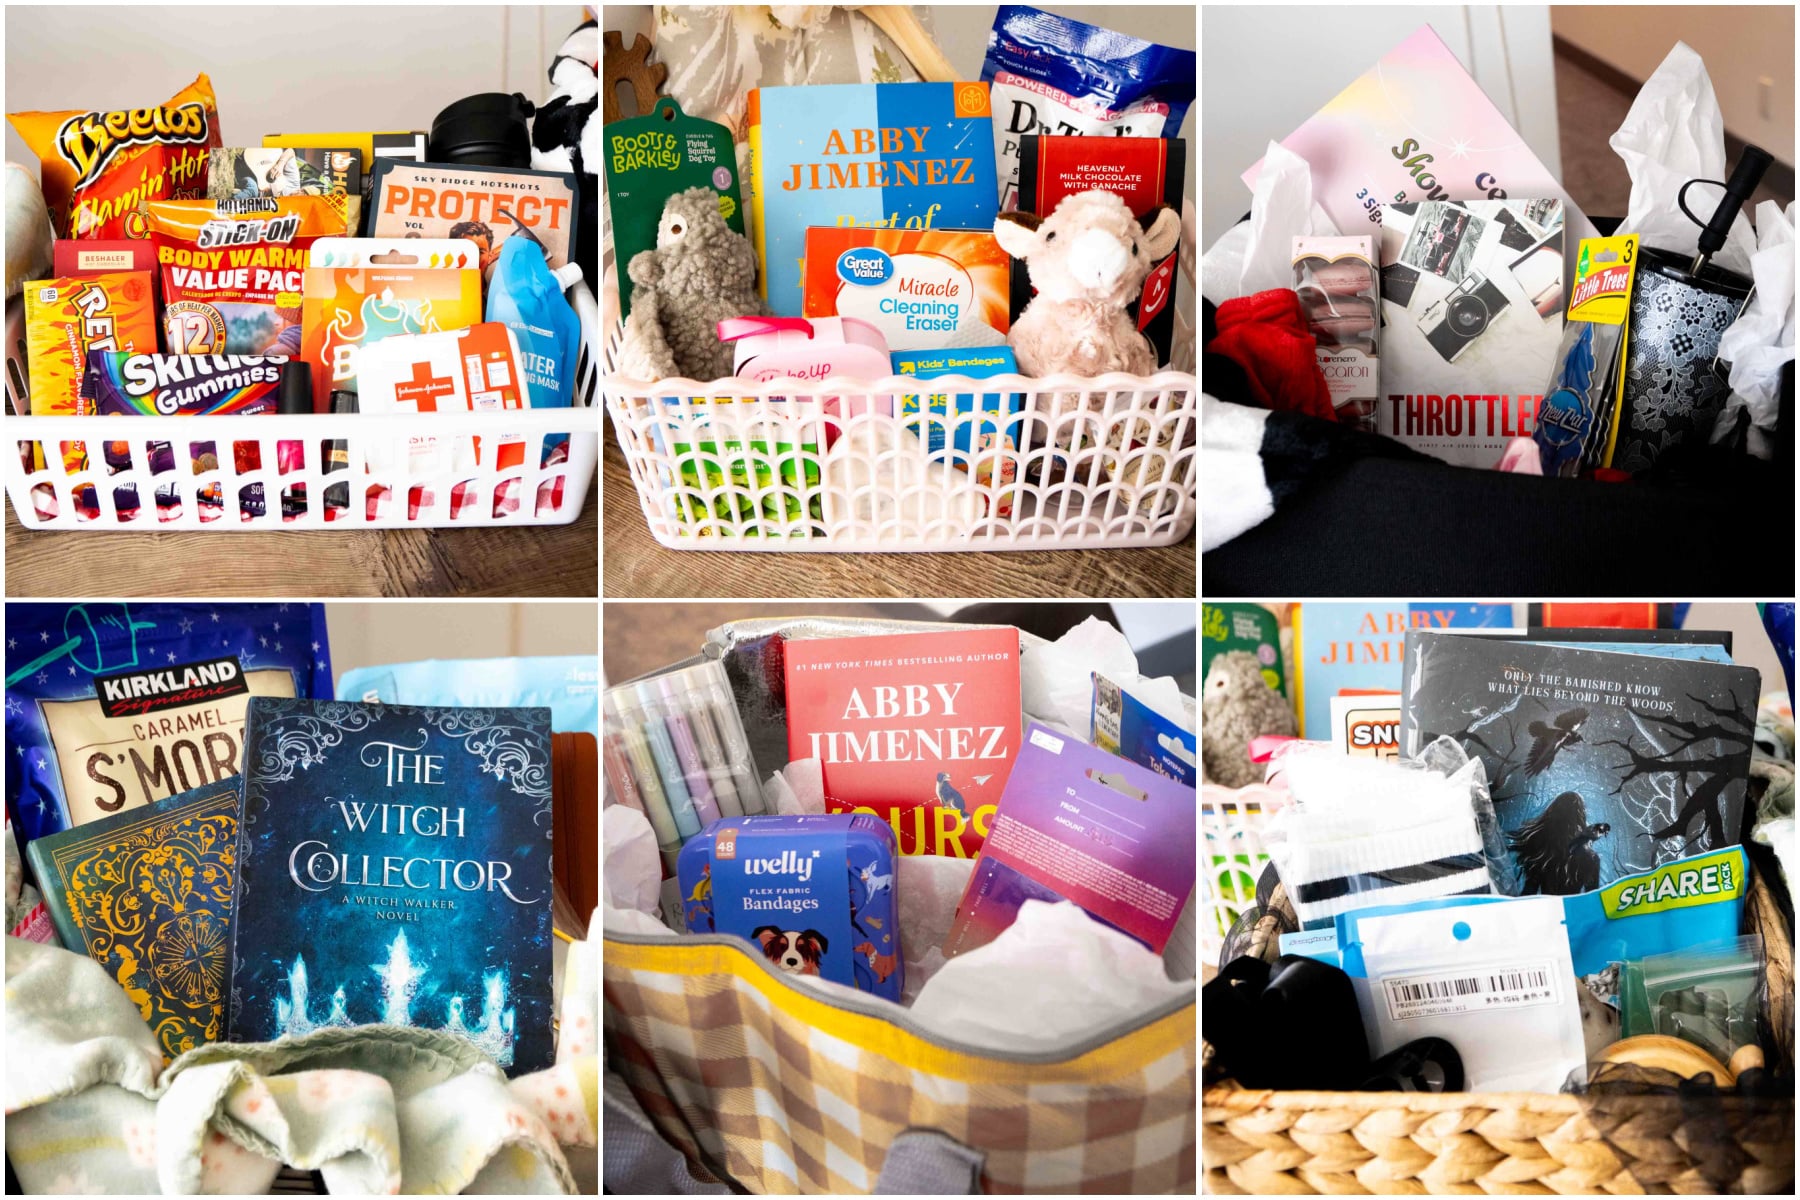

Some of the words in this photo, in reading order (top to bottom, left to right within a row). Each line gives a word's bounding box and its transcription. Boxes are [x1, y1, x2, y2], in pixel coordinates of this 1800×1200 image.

[1006, 75, 1068, 104] POWERED
[1005, 99, 1051, 135] Dr
[62, 104, 203, 178] Cheetos
[611, 131, 664, 155] BOOTS
[664, 133, 678, 150] &
[686, 140, 708, 149] Flying
[687, 147, 716, 155] Squirrel
[821, 127, 931, 156] ABBY
[169, 147, 209, 187] Hot
[688, 155, 703, 163] Dog
[703, 155, 716, 163] Toy
[1076, 165, 1126, 173] HEAVENLY
[441, 178, 476, 186] RIDGE
[481, 180, 541, 191] HOTSHOTS
[782, 158, 975, 191] JIMENEZ
[1059, 173, 1082, 181] MILK
[1084, 173, 1142, 182] CHOCOLATE
[1063, 182, 1089, 190] WITH
[1091, 182, 1137, 191] GANACHE
[384, 184, 569, 230] PROTECT
[199, 217, 297, 249] STICK-ON
[405, 221, 425, 230] VOL
[159, 246, 223, 270] BODY
[1623, 239, 1634, 263] 3
[844, 256, 885, 271] Great
[853, 267, 884, 279] Value
[171, 266, 248, 291] VALUE
[254, 270, 304, 292] PAC
[898, 276, 959, 298] Miracle
[1572, 274, 1600, 308] Little
[1601, 269, 1629, 292] Trees
[879, 297, 959, 319] Cleaning
[168, 315, 211, 354] 12
[906, 314, 959, 331] Eraser
[65, 323, 81, 369] CINNAMON
[520, 351, 555, 377] ATER
[948, 357, 1005, 367] Bandages
[1321, 366, 1369, 378] caron
[156, 364, 281, 413] Gummies
[537, 375, 560, 393] MASK
[811, 662, 832, 671] NEW
[835, 660, 860, 669] YORK
[865, 659, 893, 668] TIMES
[897, 655, 963, 666] BESTSELLING
[966, 653, 1010, 663] AUTHOR
[103, 661, 237, 702] KIRKLAND
[1504, 670, 1534, 683] ONLY
[1539, 674, 1561, 686] THE
[1565, 677, 1622, 693] BANISHED
[1626, 683, 1662, 697] KNOW
[110, 685, 242, 717] Signature
[842, 683, 964, 720] ABBY
[1488, 682, 1519, 695] WHAT
[1524, 686, 1550, 697] LIES
[1554, 689, 1600, 703] BEYOND
[1604, 695, 1626, 706] THE
[1631, 697, 1674, 712] WOODS
[132, 708, 227, 742] CARAMEL
[360, 728, 445, 787] THE
[1162, 755, 1186, 776] NOTEPAD
[86, 727, 246, 813] S'MOR
[1066, 786, 1076, 797] TO
[324, 794, 466, 838] WITCH
[1060, 801, 1080, 815] FROM
[1054, 815, 1086, 833] AMOUNT
[717, 841, 735, 852] 48
[289, 841, 540, 905] COLLECTOR
[744, 850, 812, 882] welly
[1721, 863, 1734, 890] PACK
[1616, 865, 1719, 911] SHARE
[342, 896, 350, 904] A
[356, 896, 399, 907] WITCH
[404, 898, 455, 910] WALKER
[743, 896, 820, 914] Bandages
[376, 911, 420, 922] NOVEL
